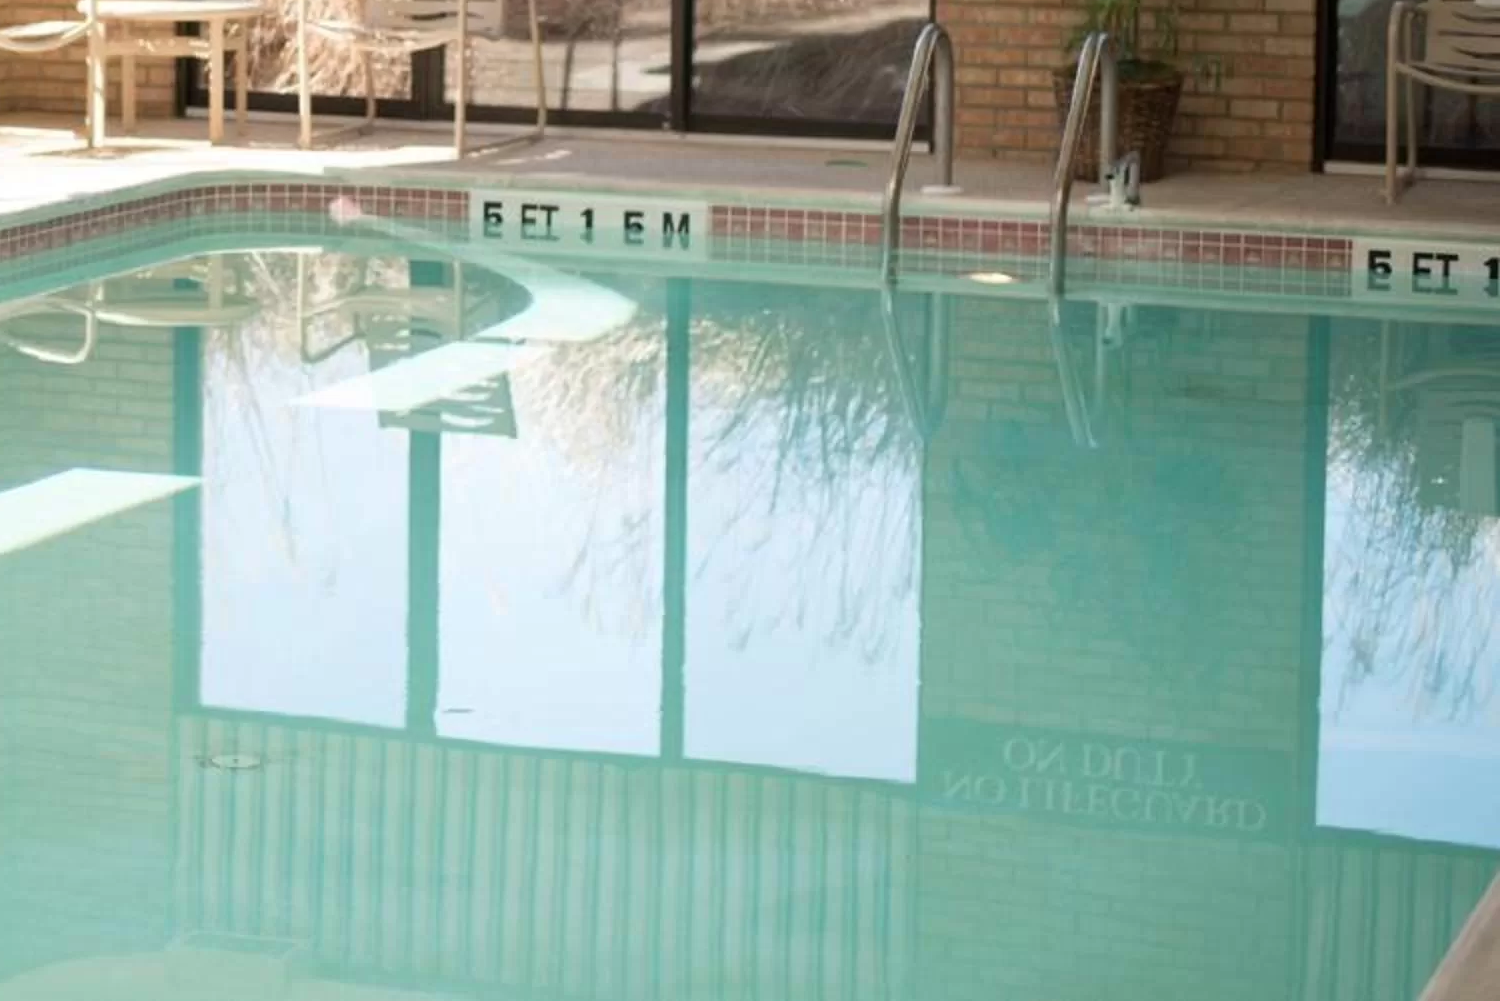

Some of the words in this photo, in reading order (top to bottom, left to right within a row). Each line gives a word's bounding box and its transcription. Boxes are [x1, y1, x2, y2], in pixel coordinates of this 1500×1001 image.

[483, 200, 504, 226] 5
[520, 202, 560, 228] FT
[580, 207, 594, 231] 1
[624, 209, 645, 234] 5
[662, 211, 691, 235] M
[1367, 249, 1393, 279] 5
[1411, 251, 1460, 278] FT
